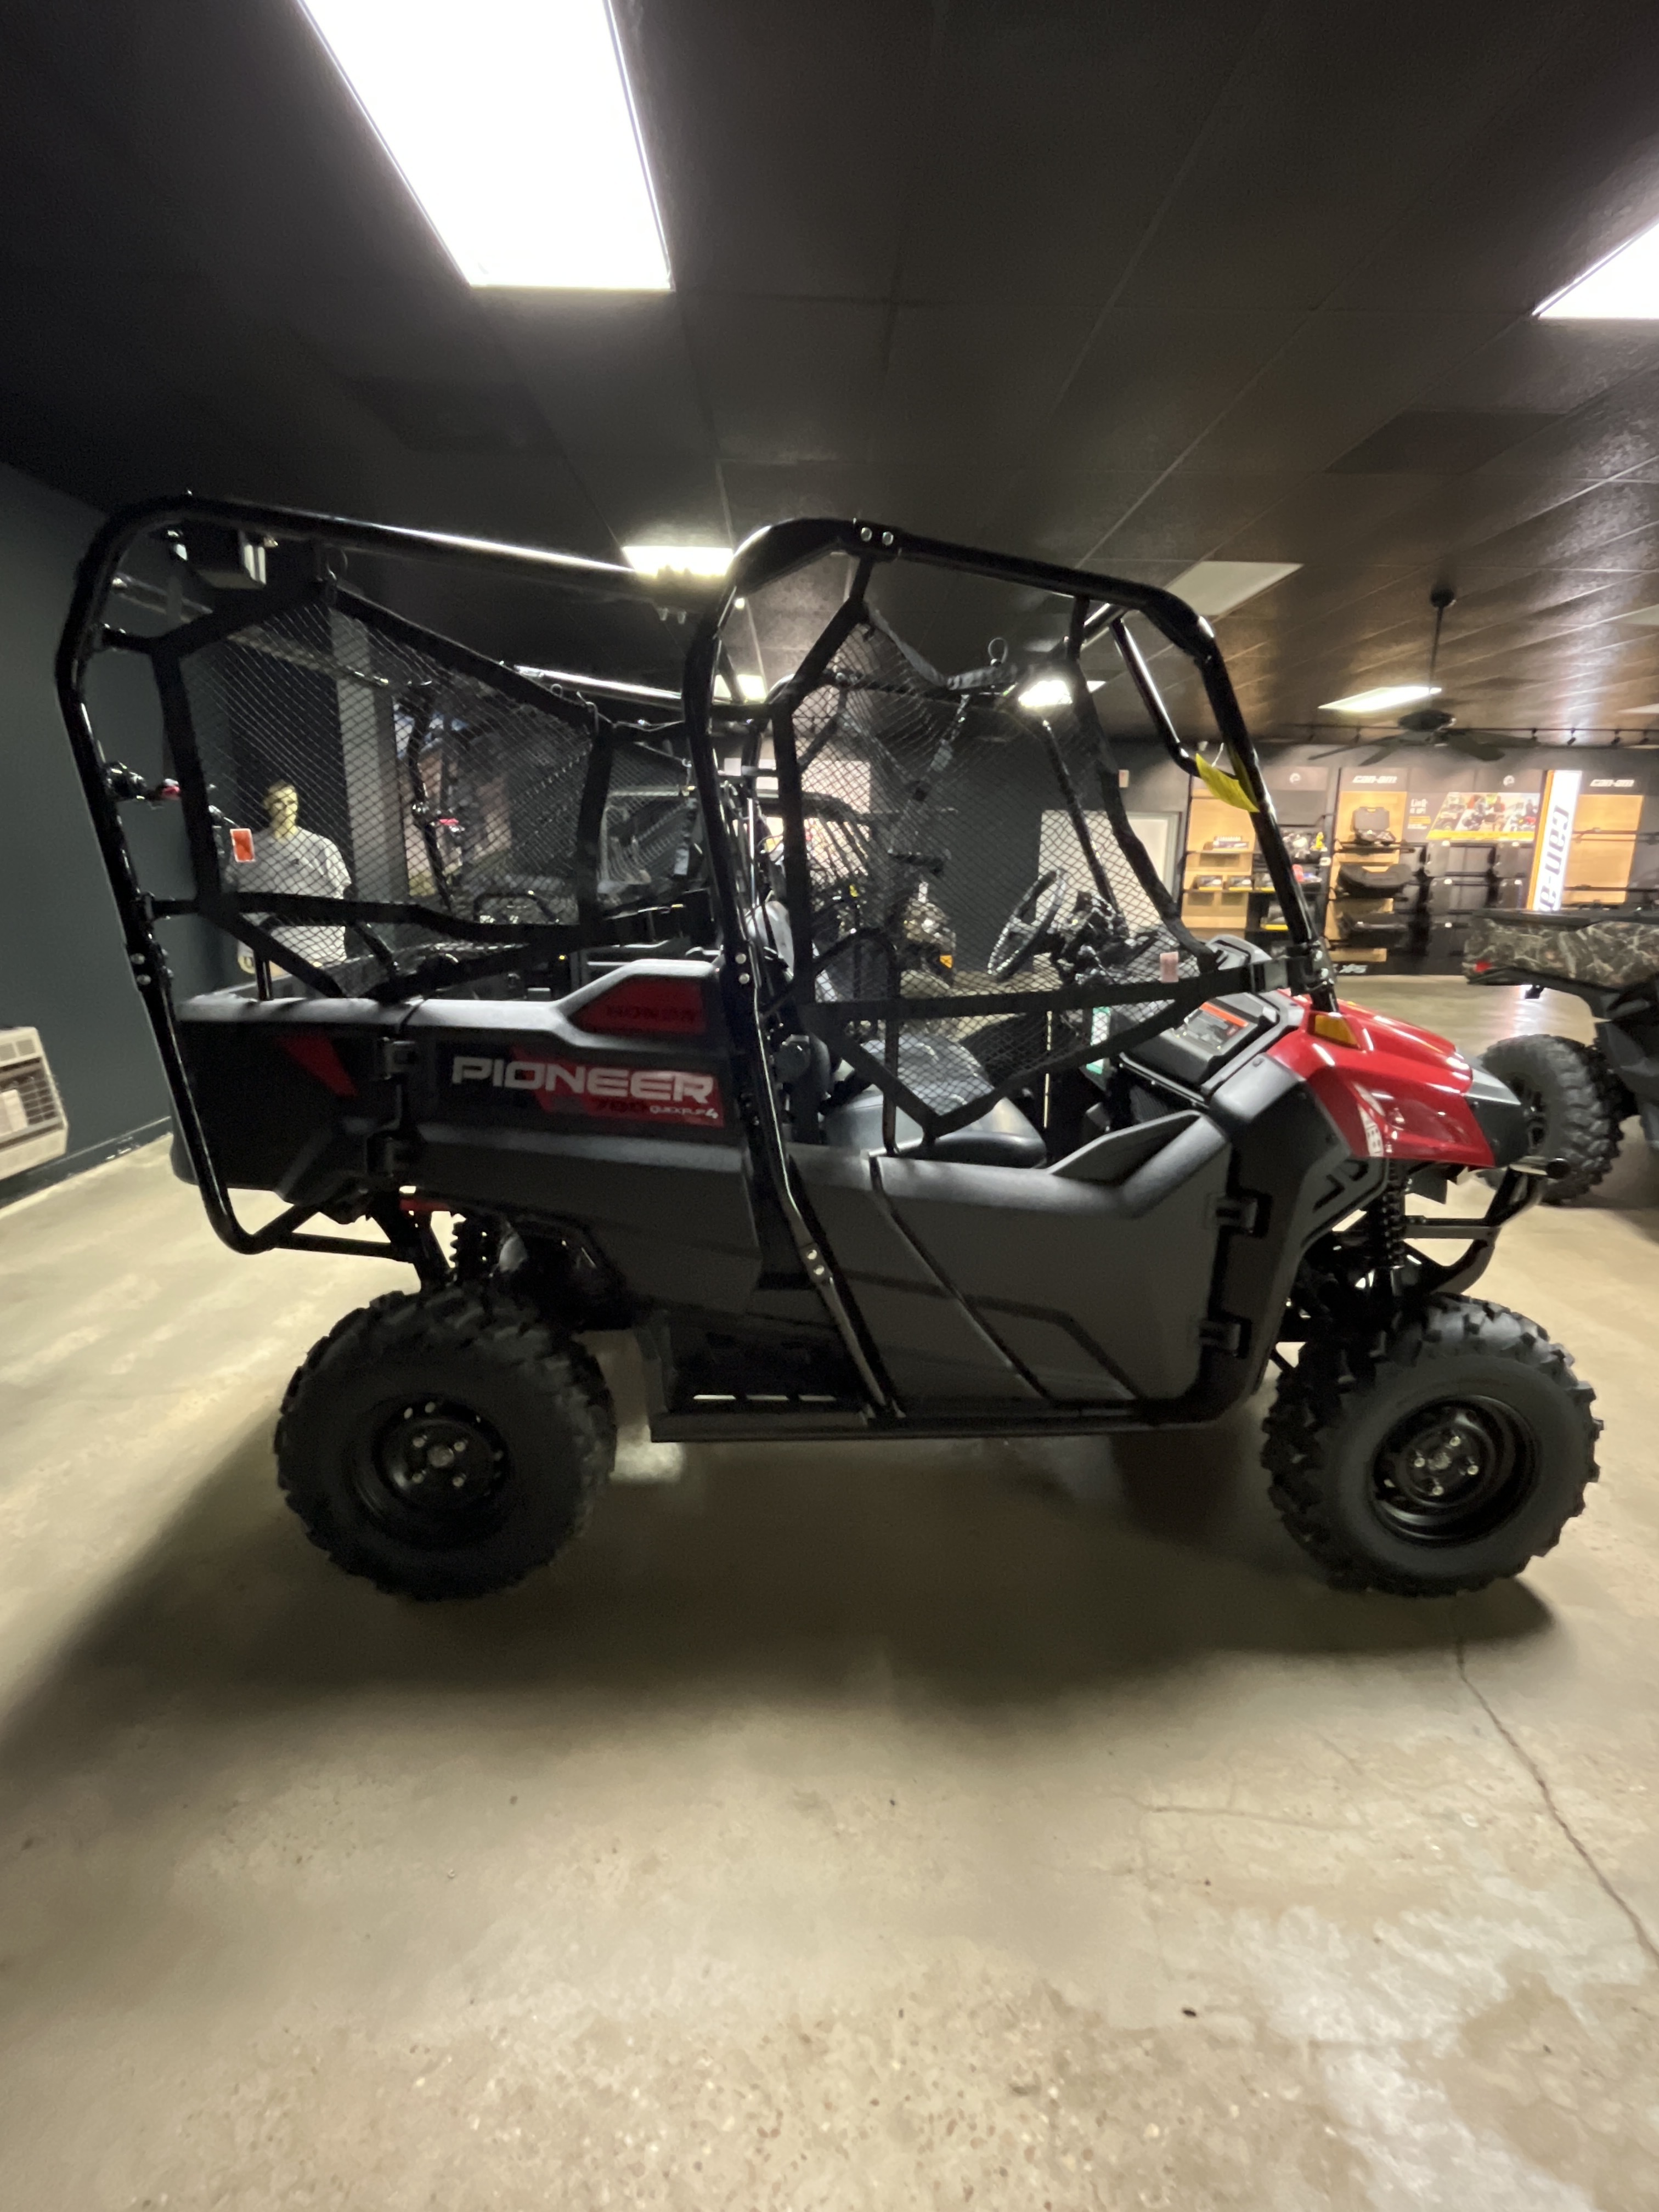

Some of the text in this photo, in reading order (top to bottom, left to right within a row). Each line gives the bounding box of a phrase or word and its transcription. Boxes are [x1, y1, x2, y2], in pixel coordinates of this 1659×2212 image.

[1590, 779, 1635, 787] can-am
[1538, 804, 1569, 911] can-a
[451, 1056, 714, 1104] PIONEER
